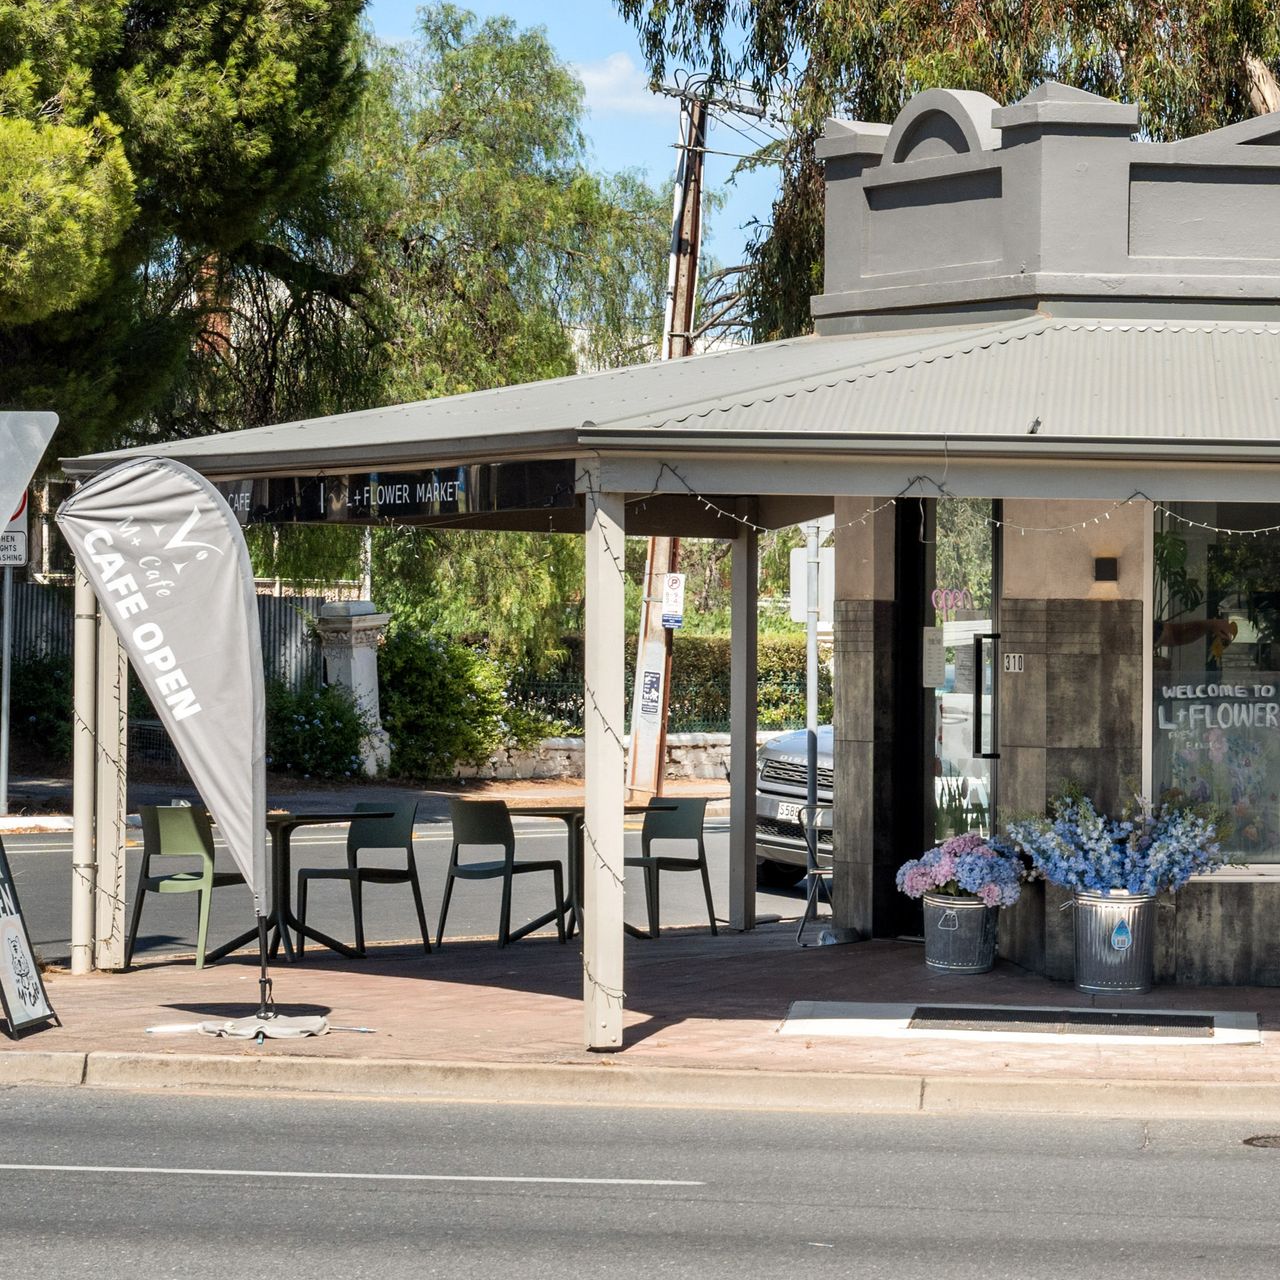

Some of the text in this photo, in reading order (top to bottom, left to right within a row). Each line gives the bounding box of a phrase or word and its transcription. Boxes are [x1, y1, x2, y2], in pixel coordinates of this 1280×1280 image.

[227, 493, 250, 511] CAFE
[416, 481, 460, 503] MARKET
[1, 535, 15, 543] HEN
[0, 544, 17, 552] GHTS
[138, 556, 175, 598] Cafe
[83, 527, 202, 722] CAFE OPEN
[1005, 655, 1023, 671] 310
[1162, 683, 1276, 699] WELCOME TO
